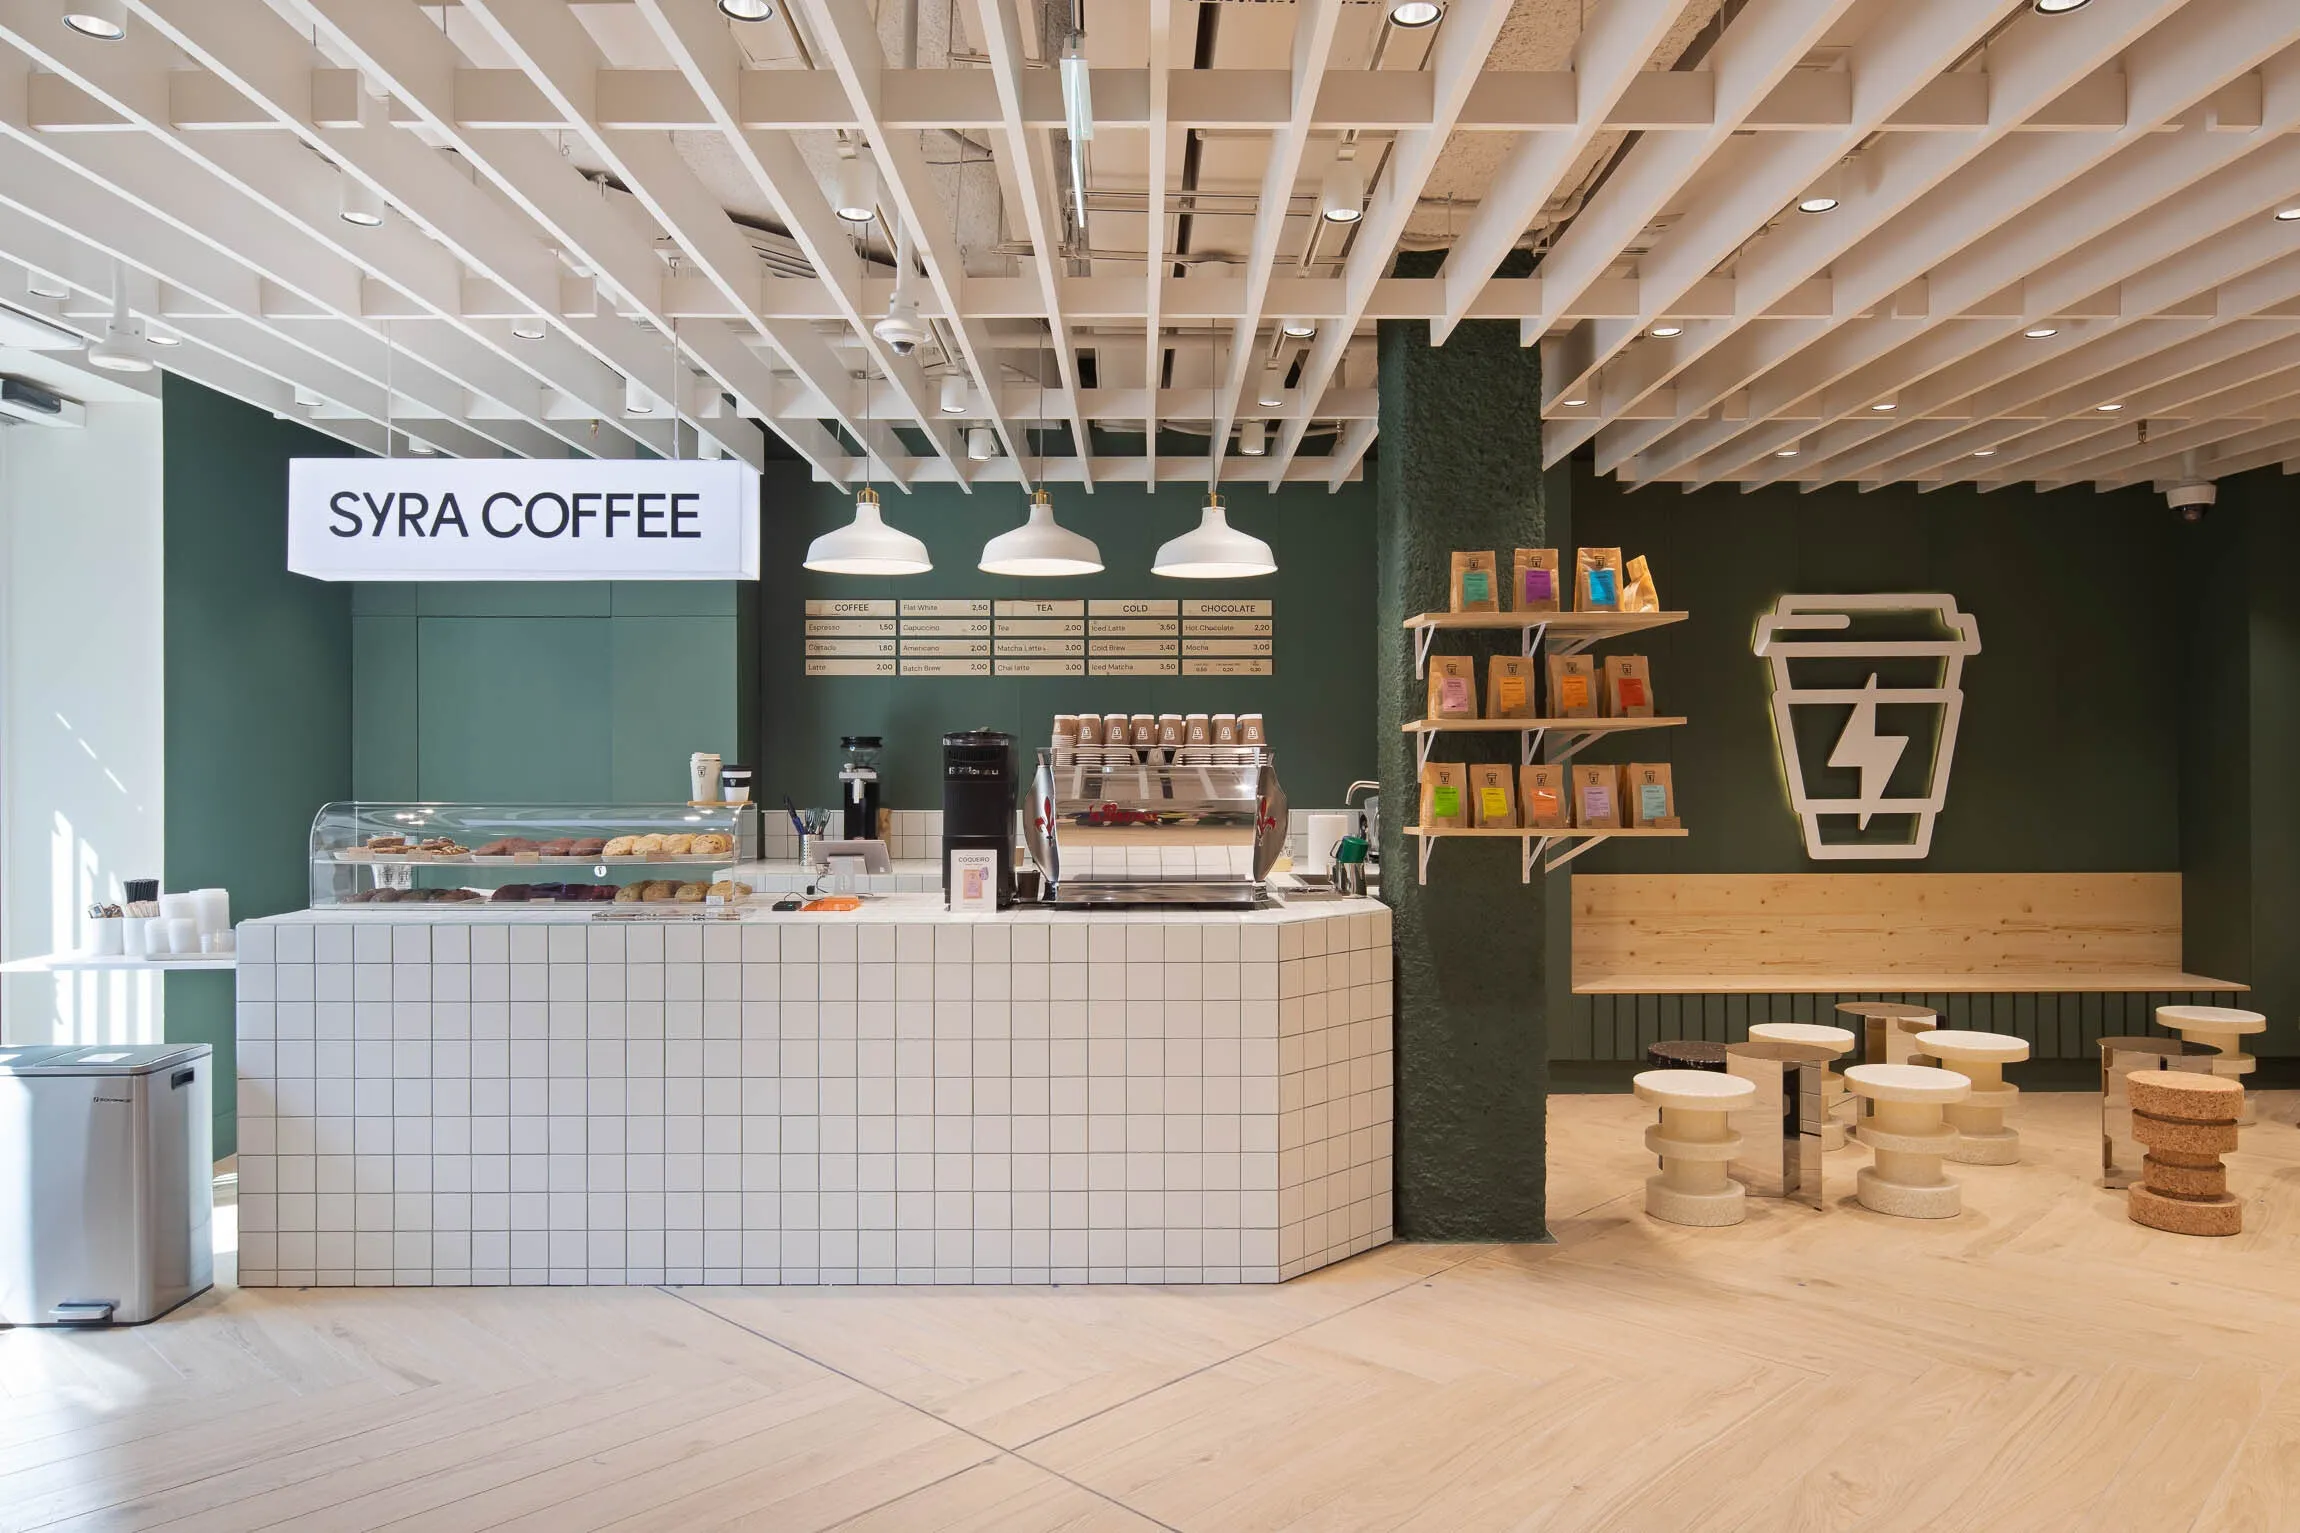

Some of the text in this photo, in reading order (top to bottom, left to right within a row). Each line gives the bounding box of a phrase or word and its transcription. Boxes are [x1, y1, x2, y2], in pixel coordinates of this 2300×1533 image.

[329, 491, 701, 539] SYRA COFFEE
[834, 603, 869, 612] COFFEE
[1036, 604, 1053, 612] TEA
[1123, 605, 1148, 613] COLD
[1200, 605, 1255, 613] CHOCOLATE
[970, 644, 988, 652] 2,00
[876, 663, 893, 671] 2,00
[970, 663, 987, 671] 2,00
